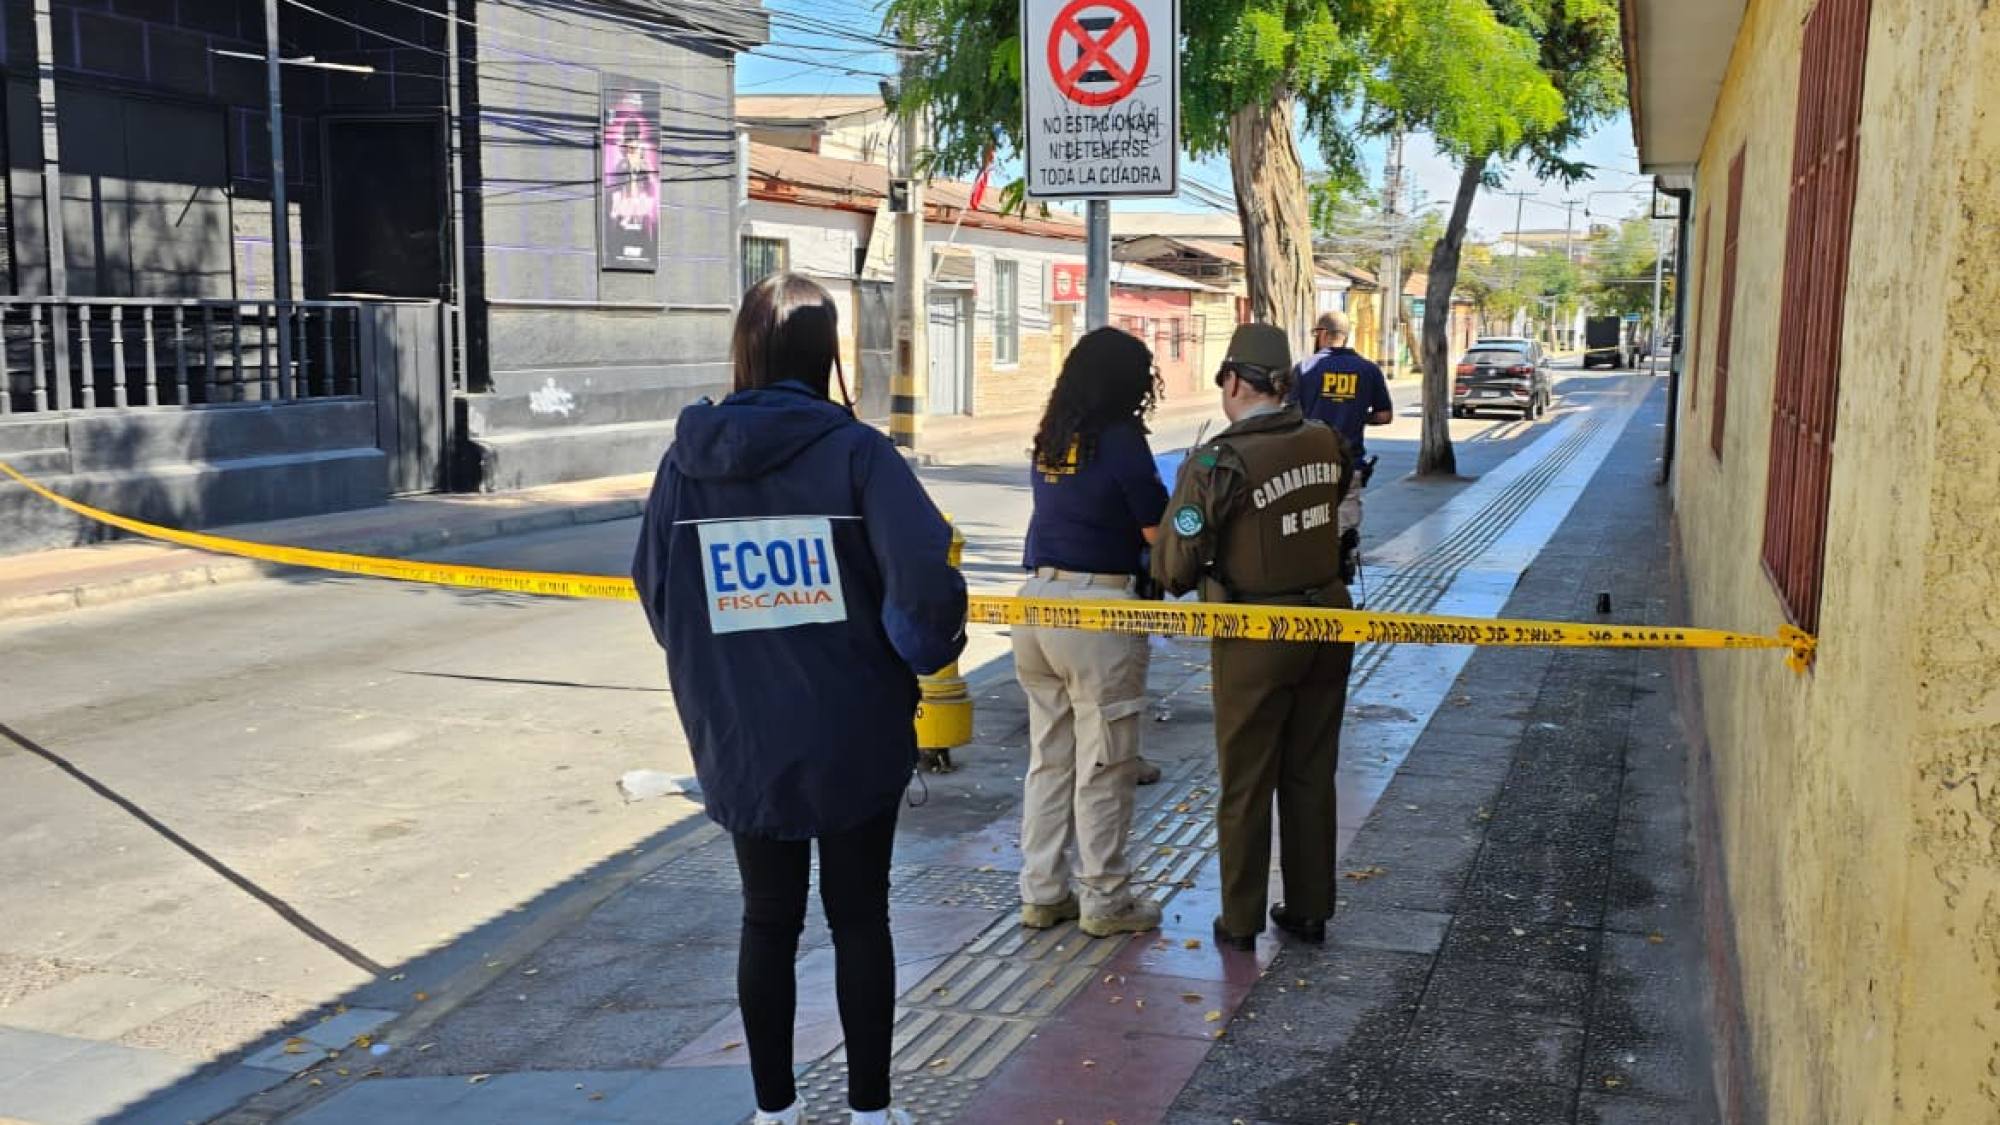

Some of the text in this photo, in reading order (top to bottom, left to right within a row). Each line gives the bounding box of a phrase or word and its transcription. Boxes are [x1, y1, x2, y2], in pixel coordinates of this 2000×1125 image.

[1043, 113, 1156, 134] NO ESTACIONAR
[1049, 140, 1149, 159] NI DETENERSE
[1040, 165, 1161, 185] TODA LA CUADRA
[1323, 372, 1357, 394] PDI
[1253, 462, 1341, 509] CARABINERO
[1282, 502, 1330, 536] DE CHILE
[709, 537, 831, 592] ECOH
[717, 589, 833, 612] FISCALIA
